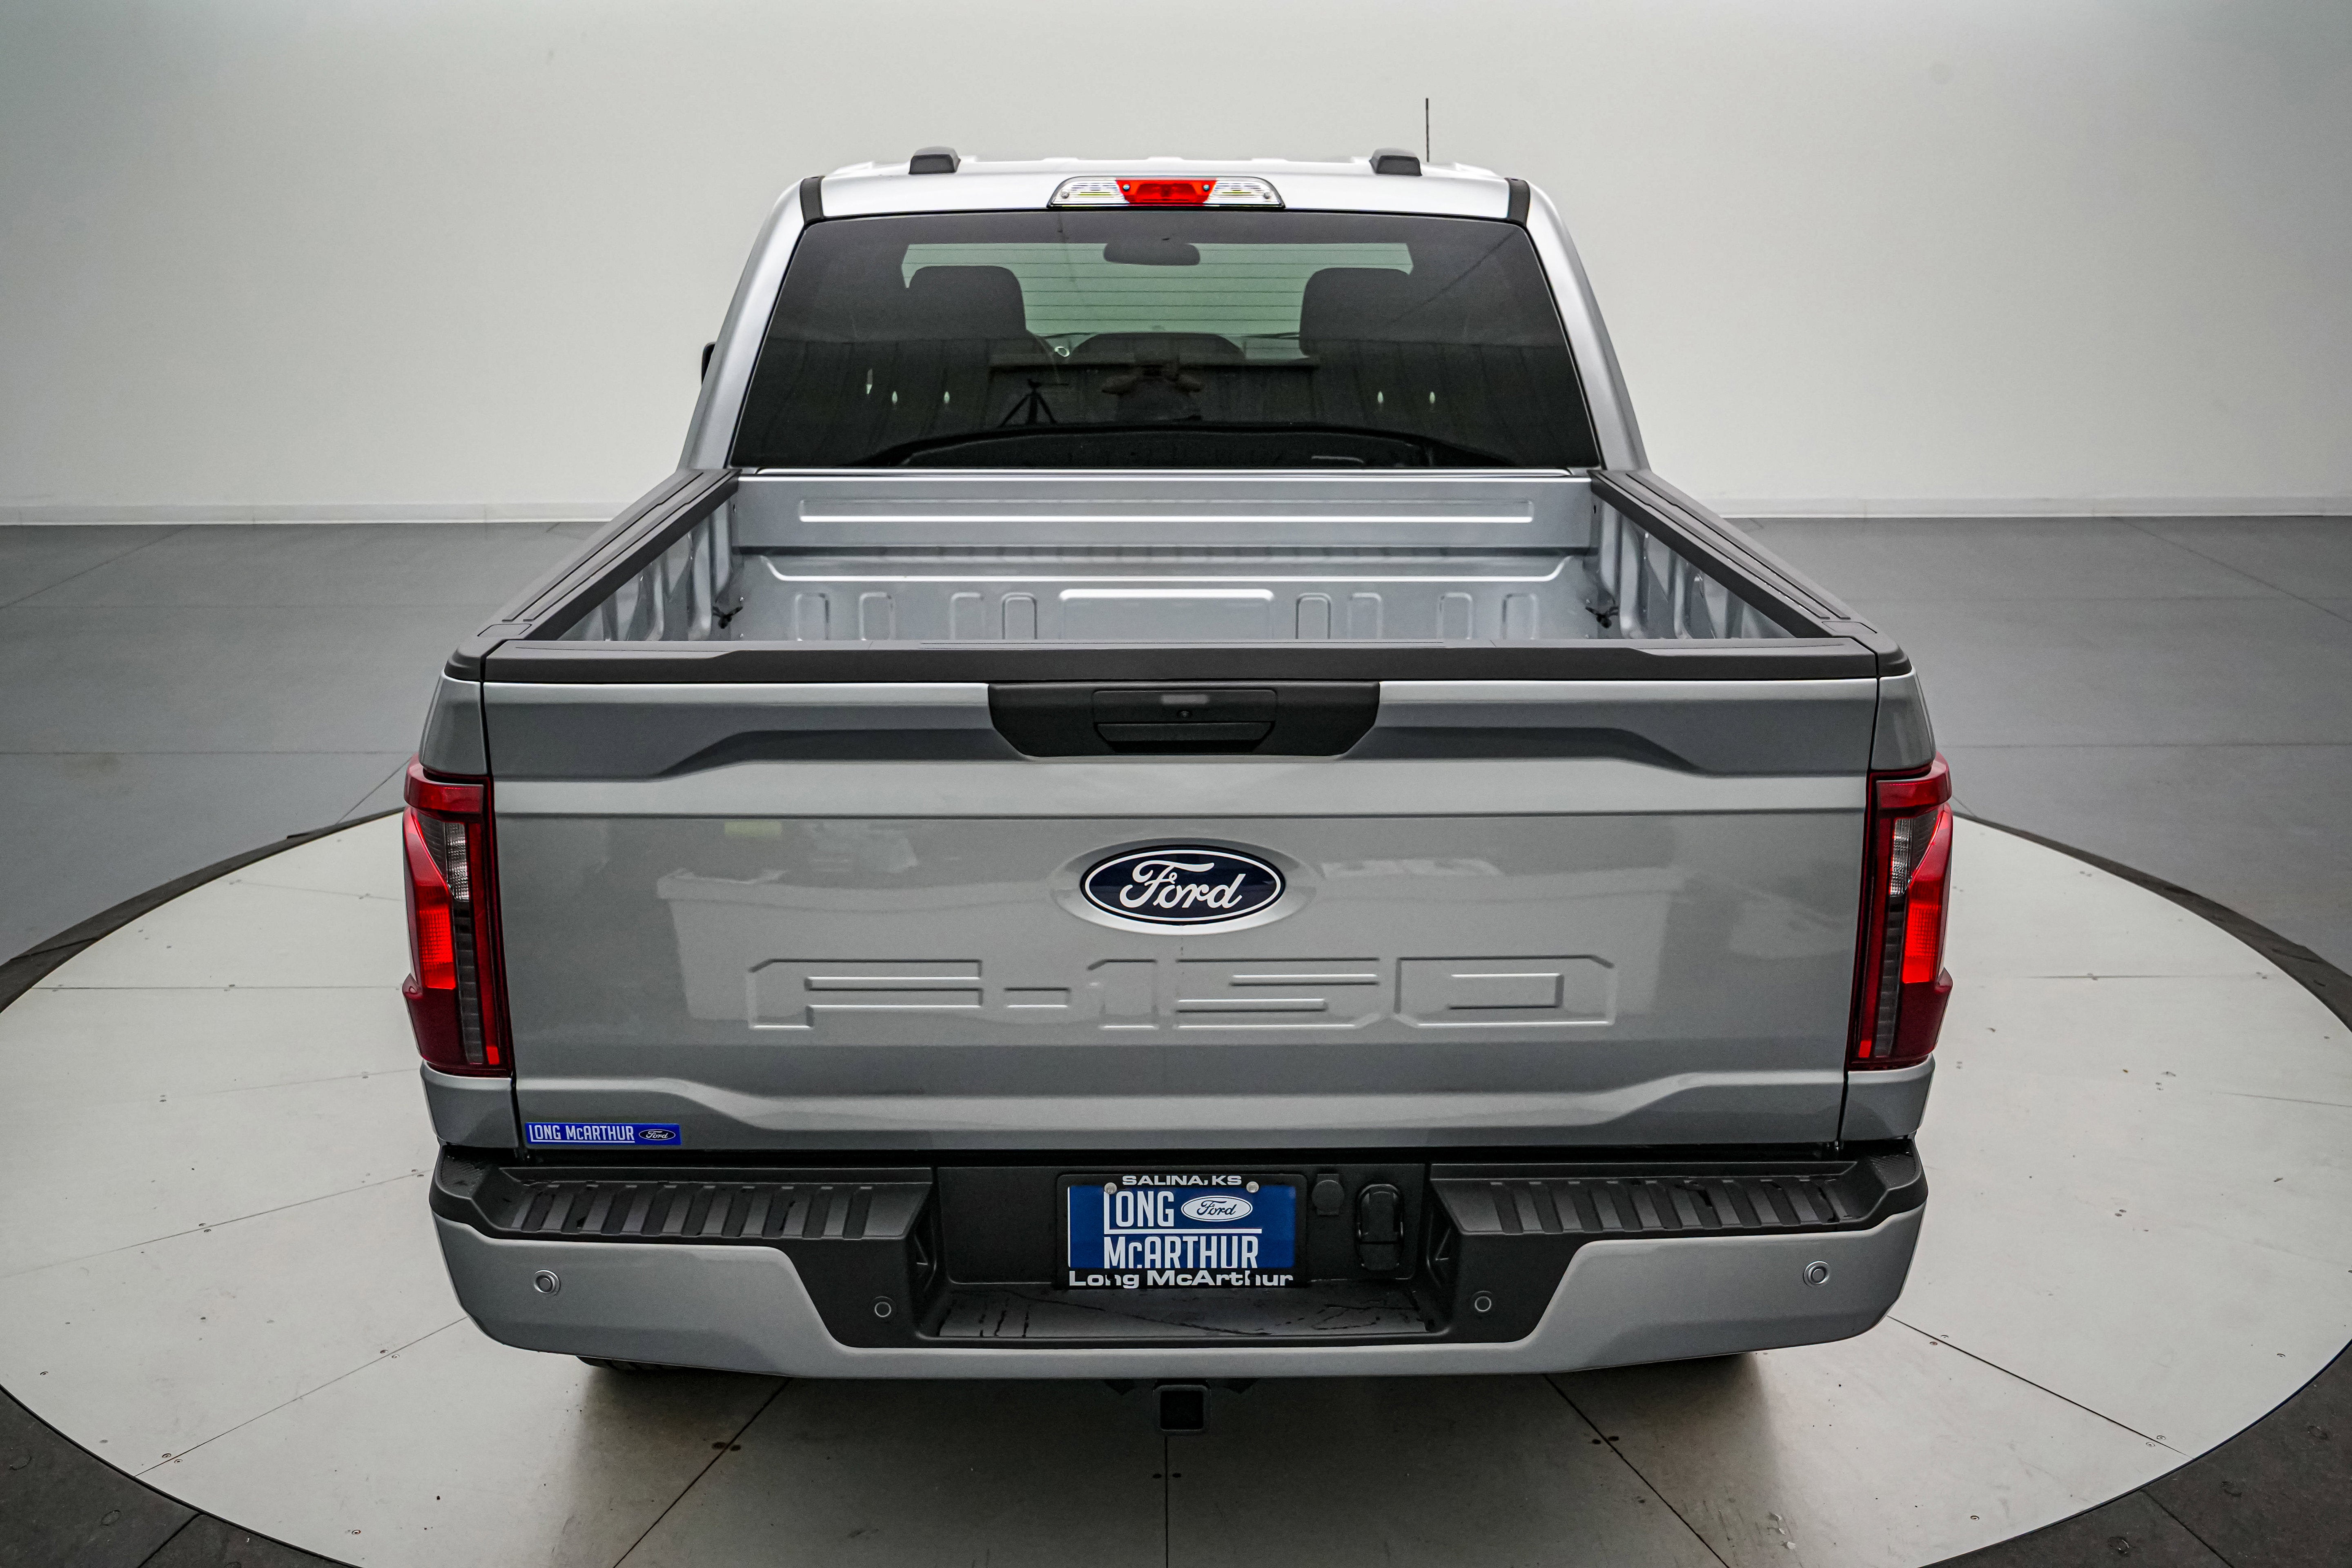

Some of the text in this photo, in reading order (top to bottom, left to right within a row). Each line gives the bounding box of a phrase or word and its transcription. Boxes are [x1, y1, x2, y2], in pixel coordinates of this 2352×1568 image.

[1120, 860, 1246, 909] Ford
[748, 956, 1616, 1030] F-150
[529, 1125, 668, 1143] LONG McARTHUR Ford
[1123, 1175, 1242, 1185] SALINA, KS
[1104, 1188, 1236, 1234] LONG Ford
[1104, 1236, 1258, 1269] McARTHUR
[1069, 1270, 1294, 1289] Long McArthur
